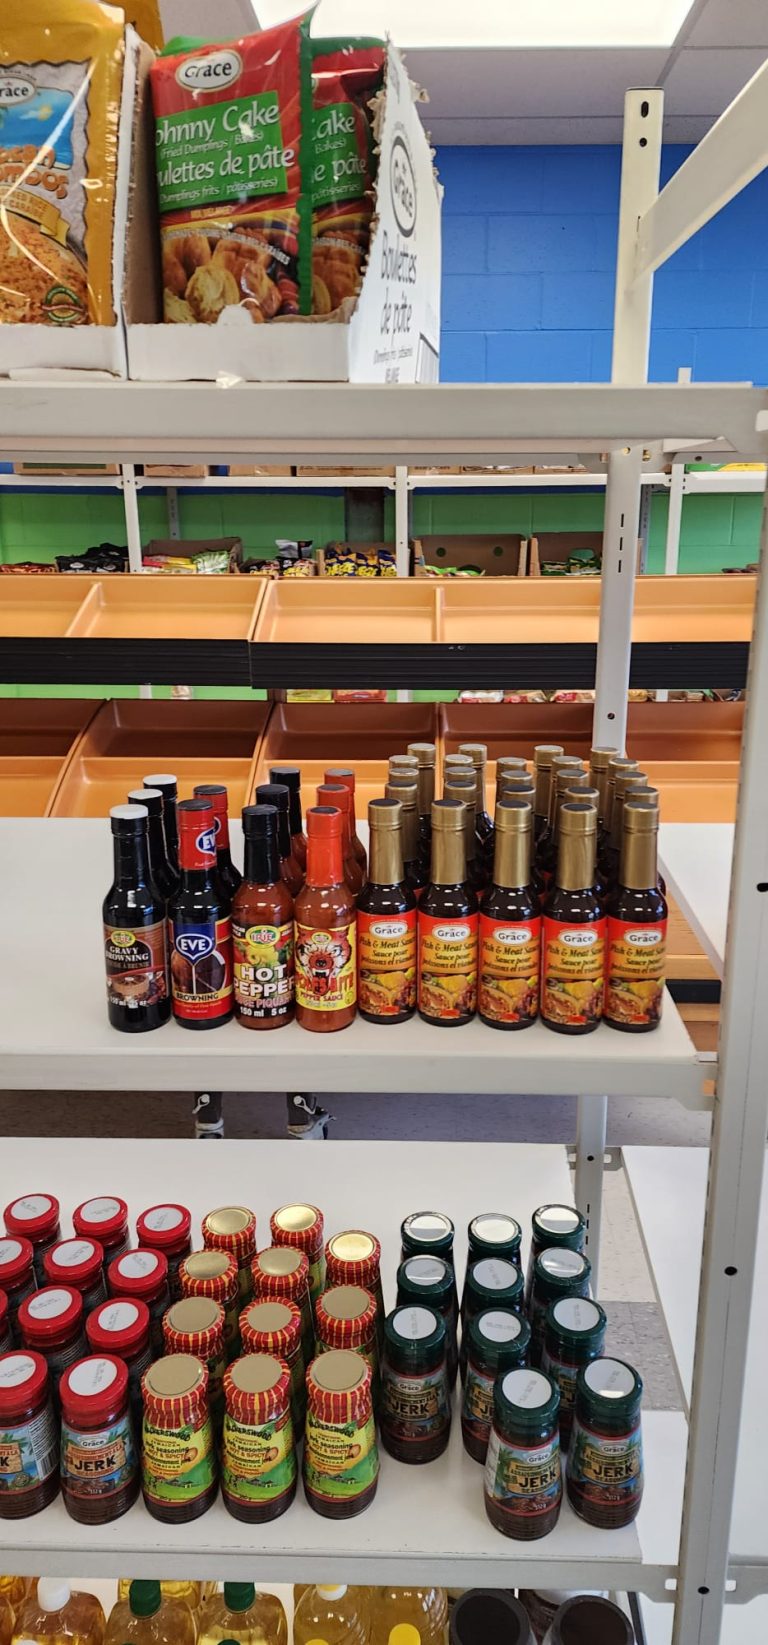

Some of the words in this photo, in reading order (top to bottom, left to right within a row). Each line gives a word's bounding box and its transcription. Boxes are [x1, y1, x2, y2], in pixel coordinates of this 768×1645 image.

[184, 62, 232, 78] Grace
[0, 86, 29, 97] race
[156, 117, 217, 146] ohnny
[222, 100, 279, 132] Cake
[312, 110, 356, 141] ake
[157, 161, 215, 187] ulettes
[220, 150, 246, 177] de
[248, 144, 295, 178] pâte
[312, 163, 326, 183] e
[374, 926, 403, 936] Grace
[437, 929, 466, 938] Grace
[498, 932, 527, 941] Grace
[563, 935, 593, 943] Grace
[629, 934, 659, 943] Grace
[180, 938, 207, 951] EVE
[373, 940, 379, 948] &
[380, 940, 400, 950] Meat
[435, 943, 441, 952] &
[442, 943, 463, 953] Meat
[109, 946, 139, 955] GRAVY
[372, 949, 392, 958] Sauce
[393, 949, 408, 960] pour
[496, 946, 502, 954] &
[502, 946, 523, 956] Meat
[561, 948, 567, 957] &
[569, 949, 590, 958] Meat
[626, 948, 633, 956] &
[634, 948, 655, 958] Meat
[435, 952, 455, 961] Sauce
[455, 953, 471, 964] pour
[495, 955, 515, 964] Sauce
[516, 955, 532, 967] pour
[561, 958, 581, 966] Sauce
[582, 958, 597, 970] pour
[626, 958, 646, 966] Sauce
[647, 957, 662, 970] pour
[241, 963, 288, 982] HOT
[176, 993, 219, 1002] BROWNING
[254, 1009, 265, 1017] ml
[271, 1007, 277, 1016] 5
[278, 1006, 287, 1015] oz
[399, 1383, 420, 1391] Grace
[391, 1401, 430, 1416] JERK
[82, 1439, 105, 1447] Grace
[320, 1441, 353, 1450] seasoning
[156, 1446, 189, 1454] seasoning
[238, 1445, 271, 1453] seasoning
[603, 1445, 625, 1453] Grace
[74, 1454, 117, 1472] JERK
[528, 1453, 549, 1463] Grace
[593, 1462, 633, 1478] JERK
[519, 1470, 556, 1488] JERK
